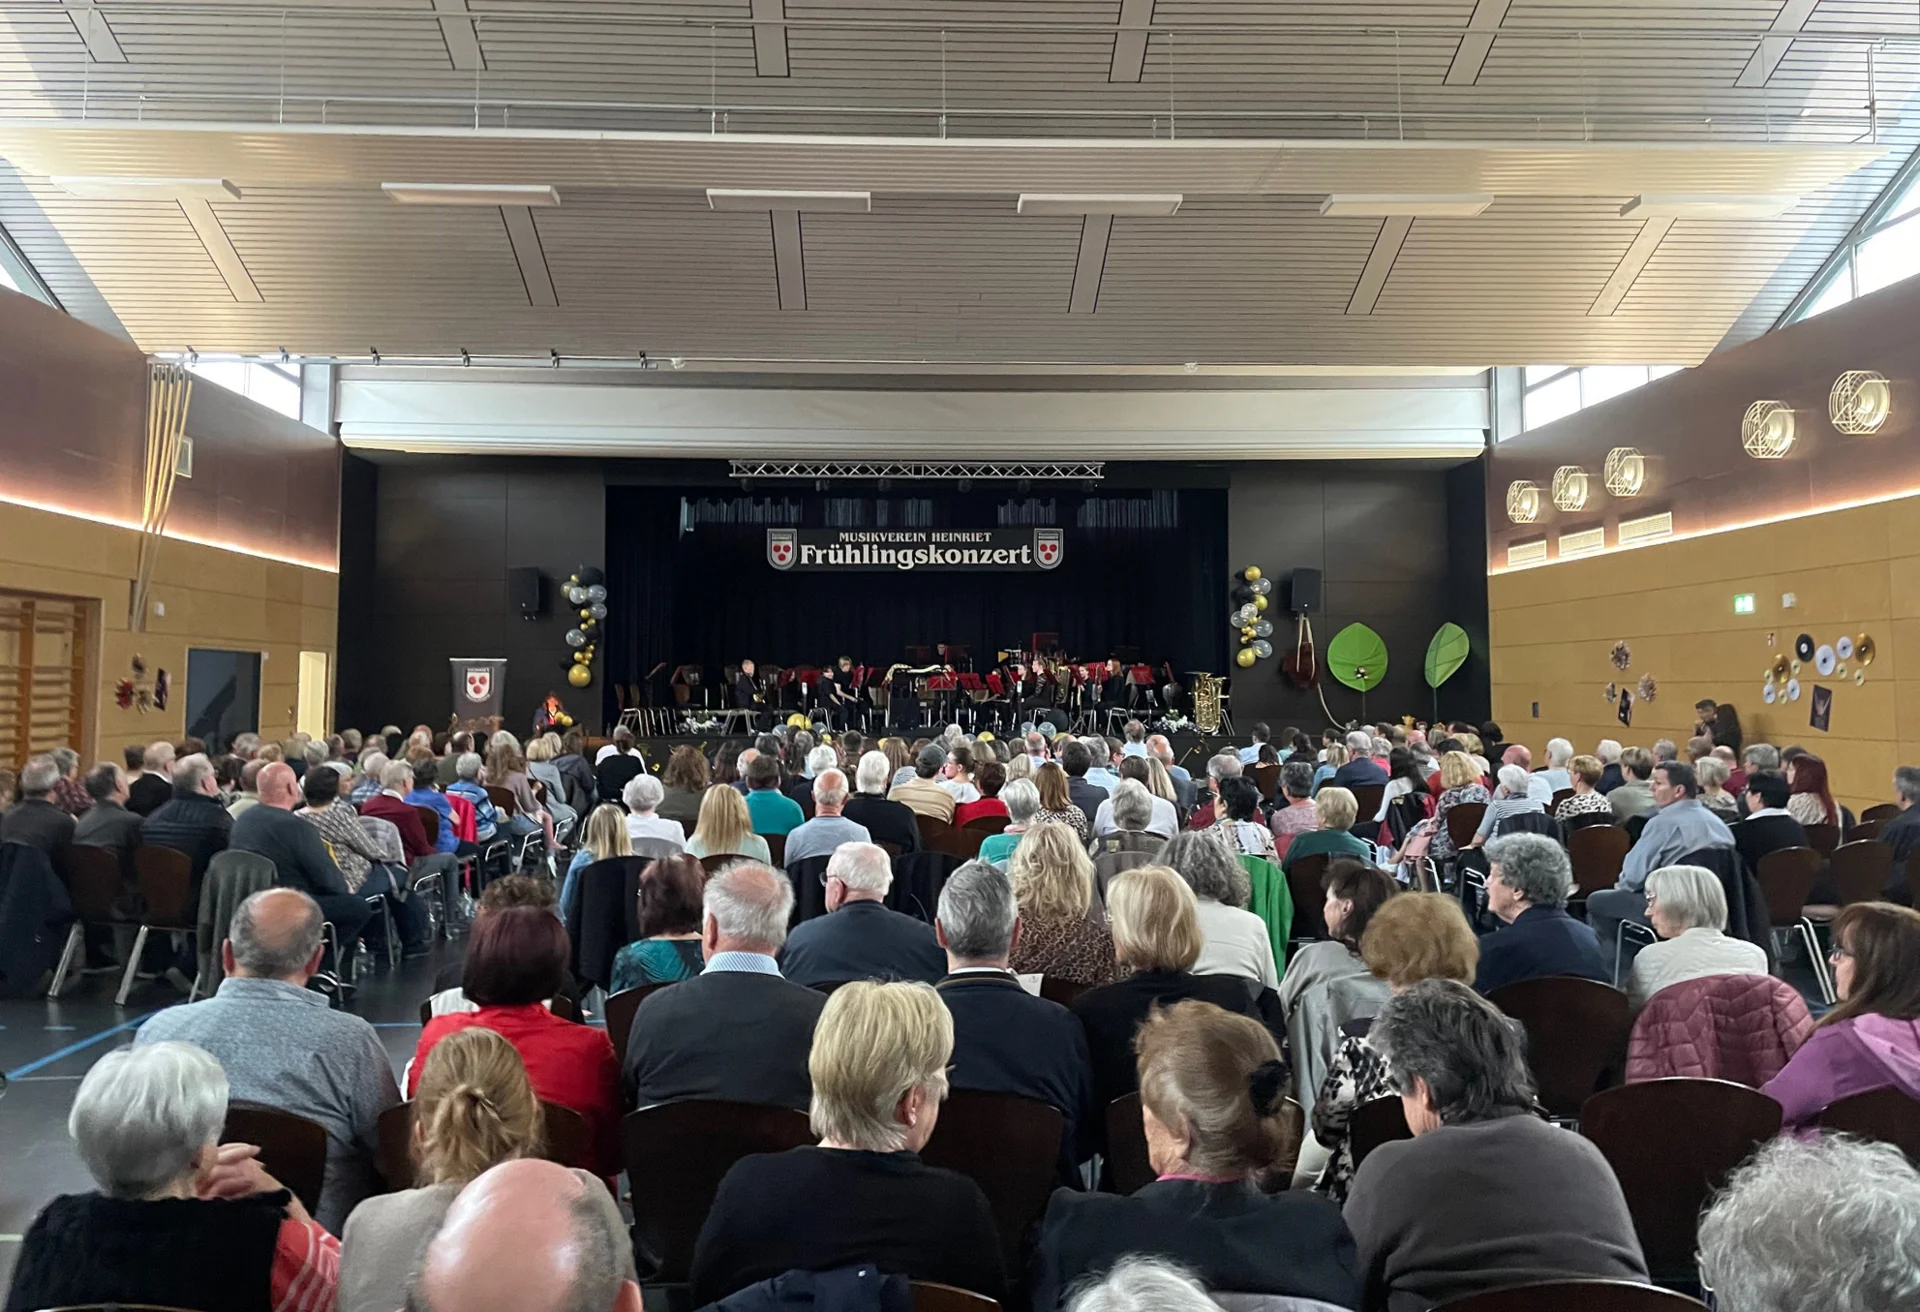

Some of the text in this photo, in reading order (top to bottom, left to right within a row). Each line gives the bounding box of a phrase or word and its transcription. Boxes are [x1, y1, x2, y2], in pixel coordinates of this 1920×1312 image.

[839, 532, 992, 543] MUSIKVEREIN HEINRIET
[800, 543, 1032, 570] Frühlingskonzert
